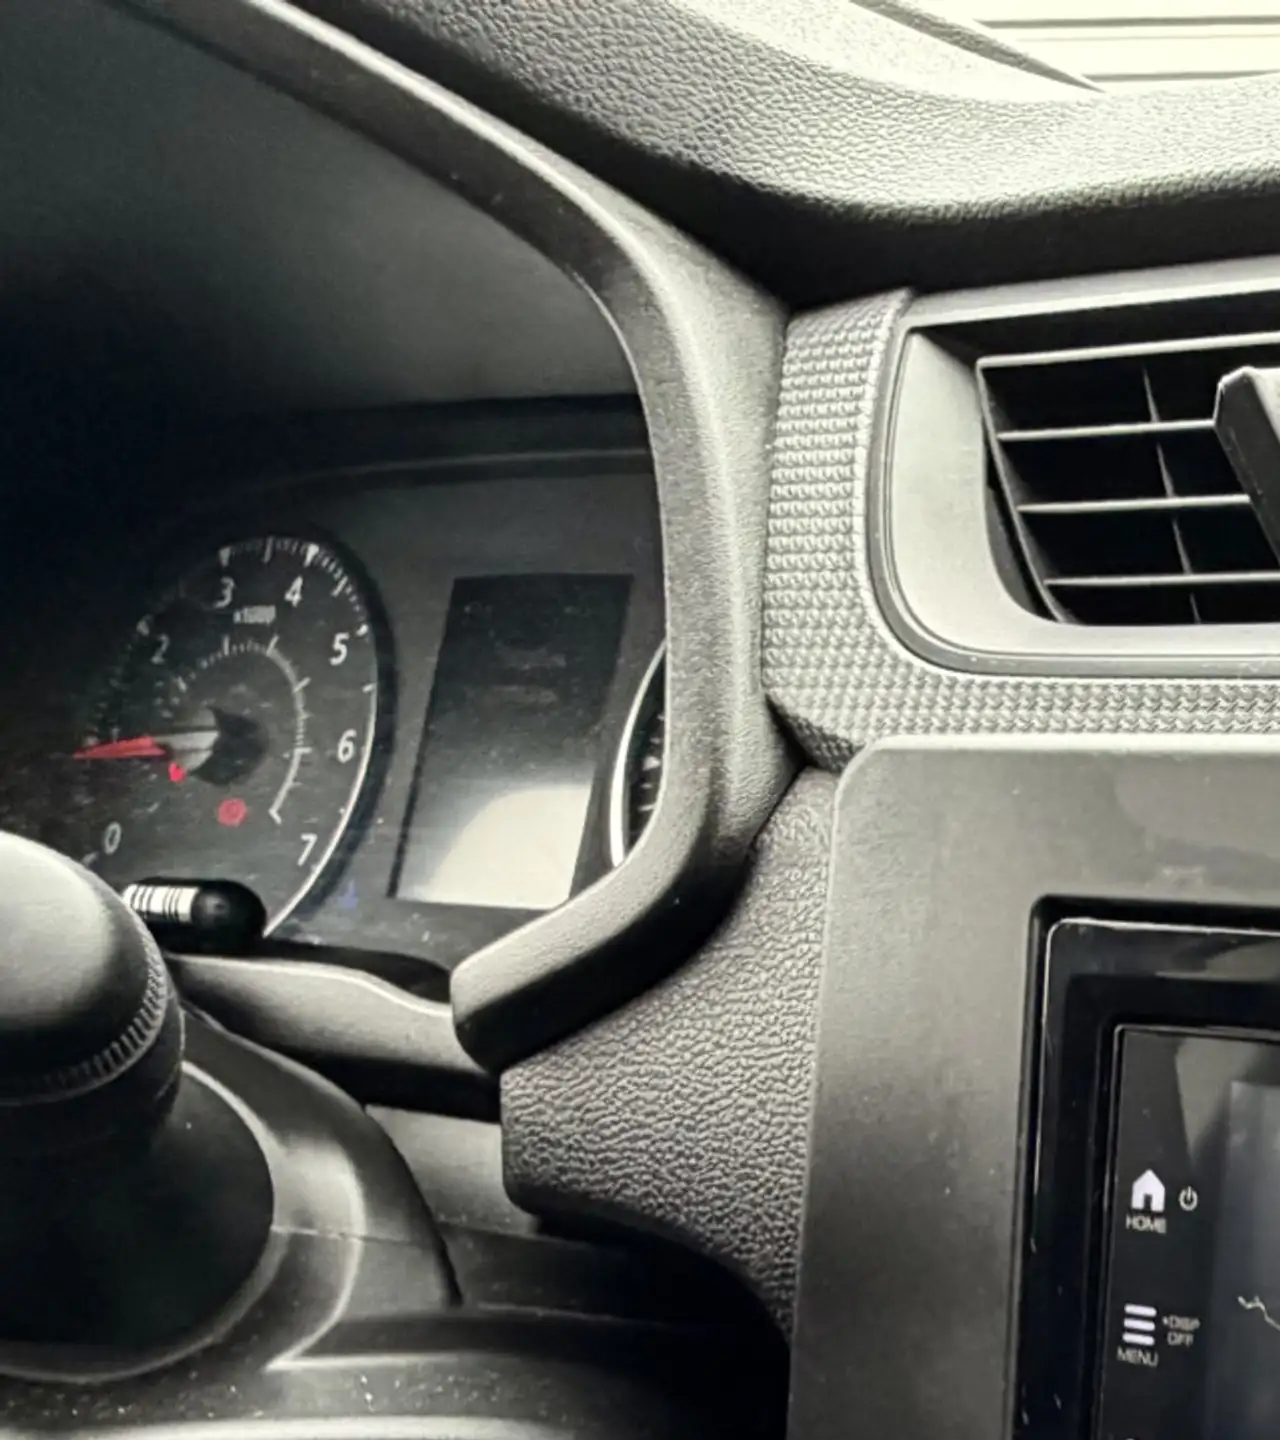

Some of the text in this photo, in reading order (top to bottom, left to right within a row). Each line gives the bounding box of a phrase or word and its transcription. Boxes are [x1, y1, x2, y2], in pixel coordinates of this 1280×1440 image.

[213, 576, 236, 609] 3
[284, 576, 304, 607] 4
[151, 634, 169, 664] 2
[330, 632, 349, 665] 5
[337, 729, 357, 763] 6
[104, 822, 122, 854] 0
[297, 834, 317, 866] 7
[1126, 1215, 1167, 1234] HOME
[1116, 1347, 1159, 1367] MENU
